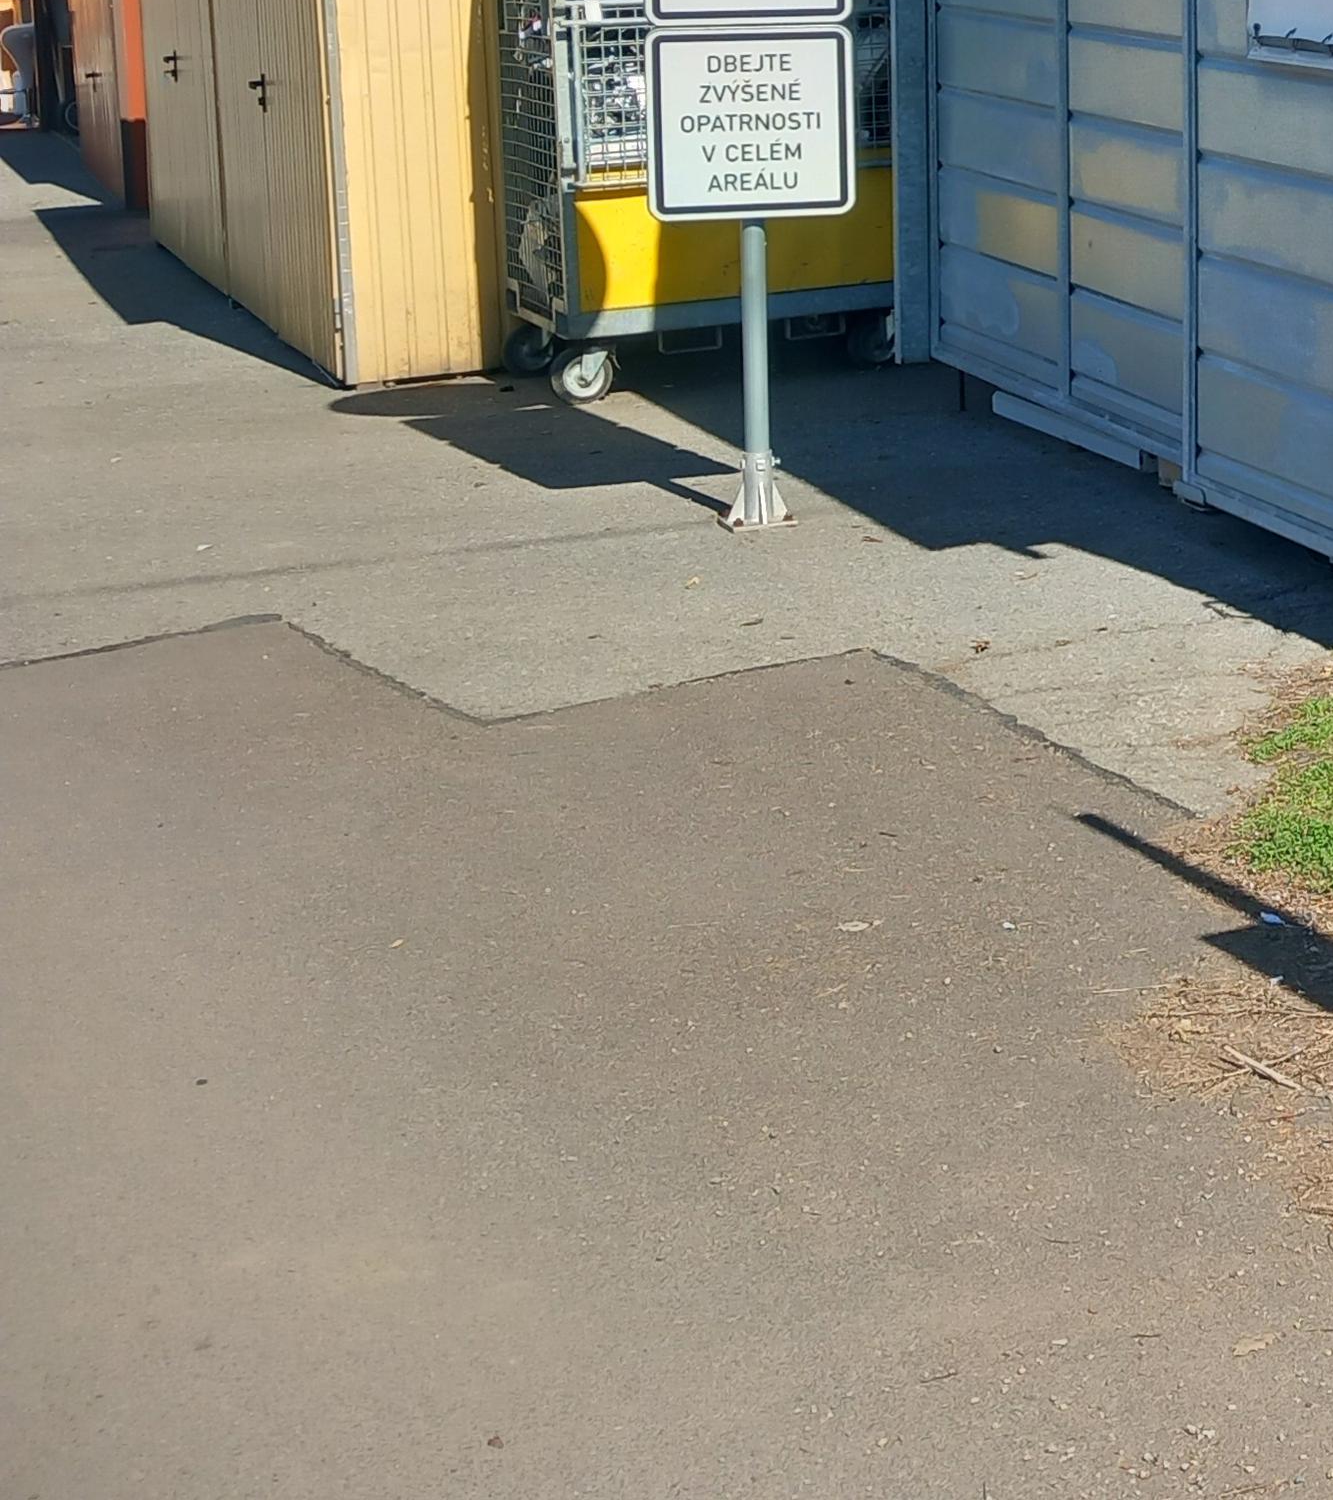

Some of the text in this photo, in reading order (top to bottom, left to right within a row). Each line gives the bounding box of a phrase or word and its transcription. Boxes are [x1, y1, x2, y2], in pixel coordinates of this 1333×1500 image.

[707, 54, 792, 73] DBEJTE
[699, 79, 801, 104] ZVÝŠENÉ
[680, 112, 821, 133] OPATRNOSTI
[701, 139, 802, 162] V CELÉM
[707, 168, 799, 192] AREÁLU
